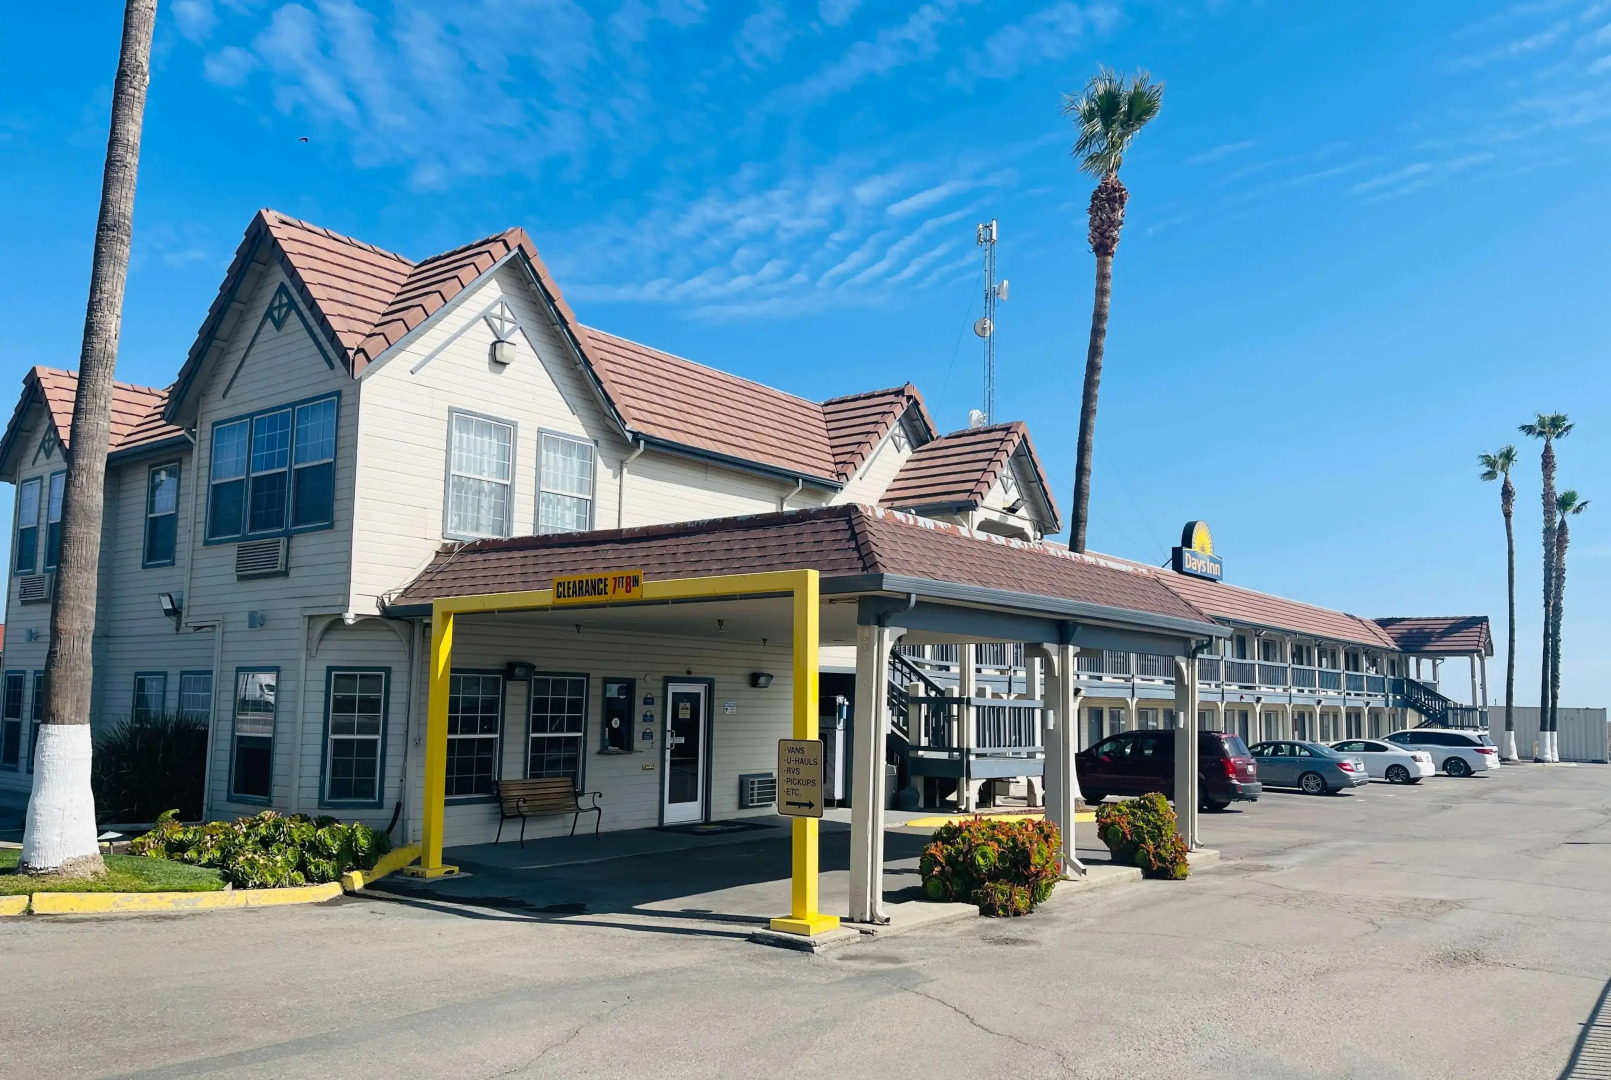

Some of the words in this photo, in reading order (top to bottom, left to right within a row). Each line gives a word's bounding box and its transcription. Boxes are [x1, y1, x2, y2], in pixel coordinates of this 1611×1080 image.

[1185, 552, 1206, 573] Days
[1207, 558, 1220, 576] Inn
[556, 577, 608, 599] CLEARANCE
[787, 746, 805, 755] VANS
[786, 757, 818, 766] U-HAULS
[786, 767, 801, 775] RVS
[786, 777, 817, 787] PICKUPS
[786, 788, 802, 796] ETC.
